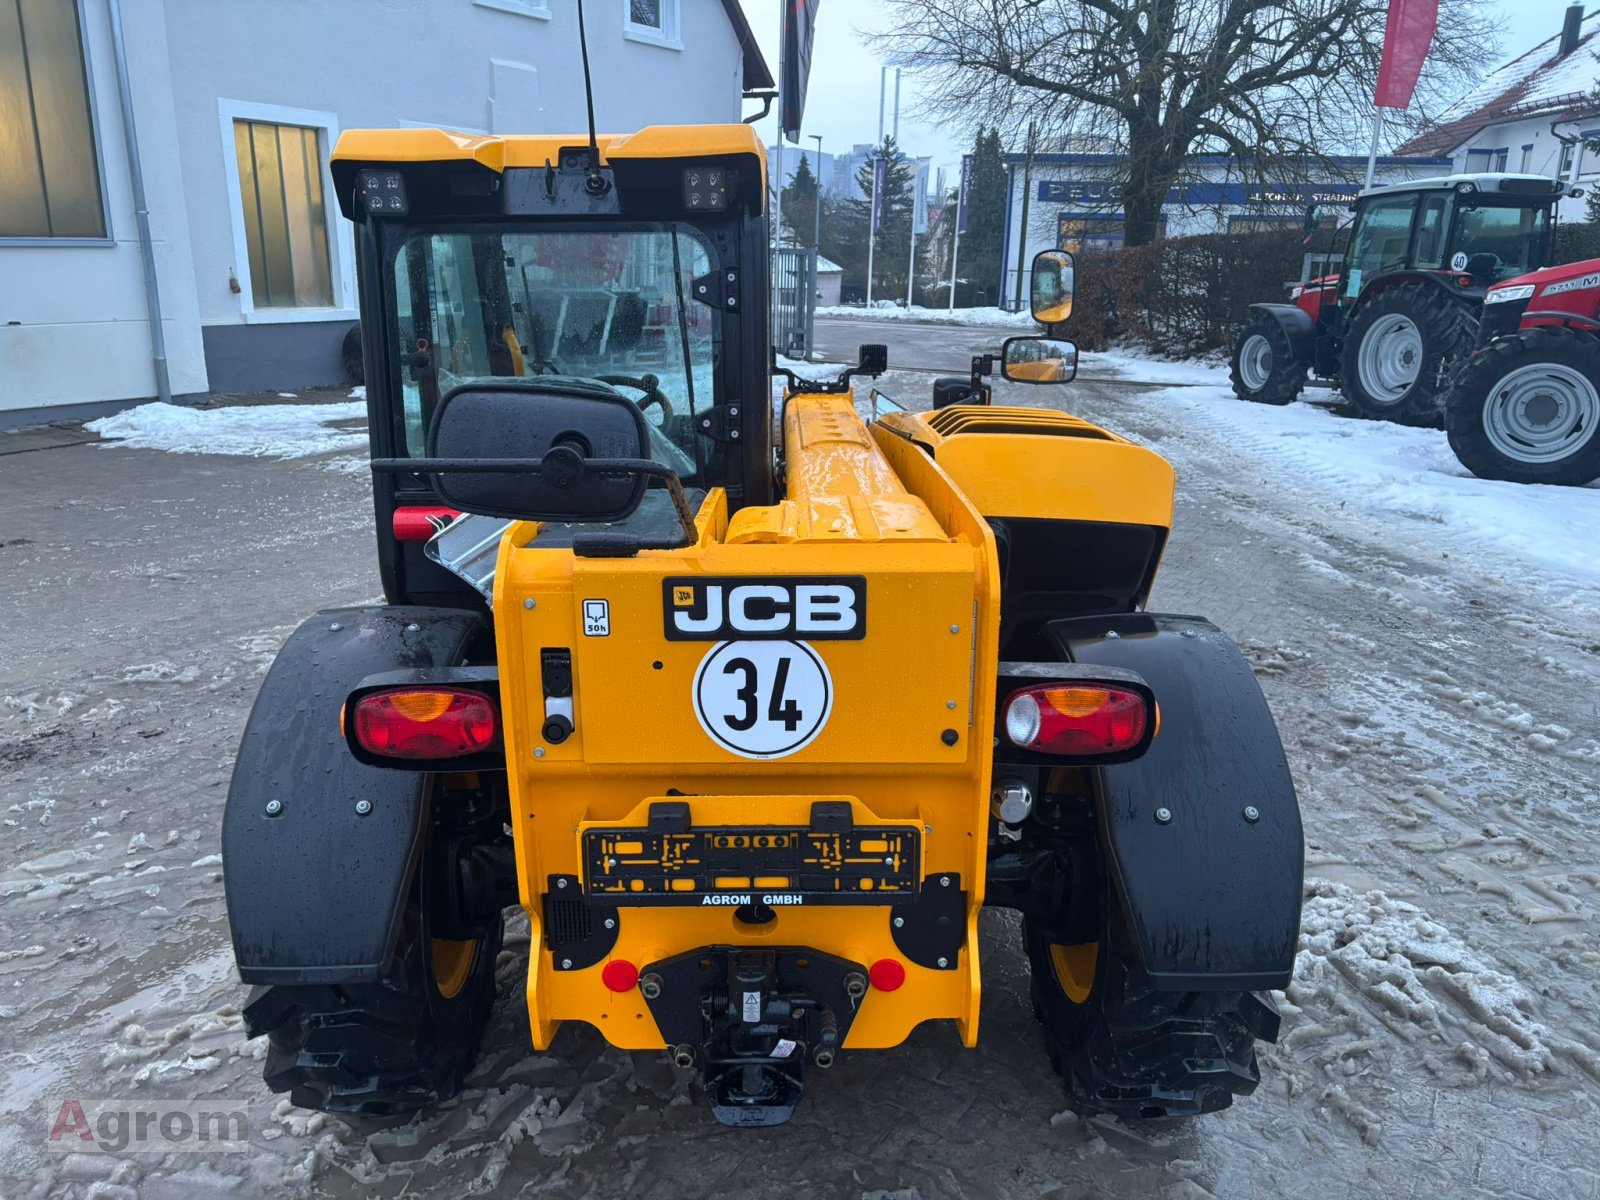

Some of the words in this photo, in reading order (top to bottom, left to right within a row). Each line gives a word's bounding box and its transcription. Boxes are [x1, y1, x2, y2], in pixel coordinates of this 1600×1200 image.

[1453, 255, 1465, 269] 40
[674, 585, 857, 632] JCB
[587, 624, 606, 632] 50h
[722, 657, 802, 731] 34
[702, 894, 751, 905] AGROM
[762, 894, 803, 905] GMBH
